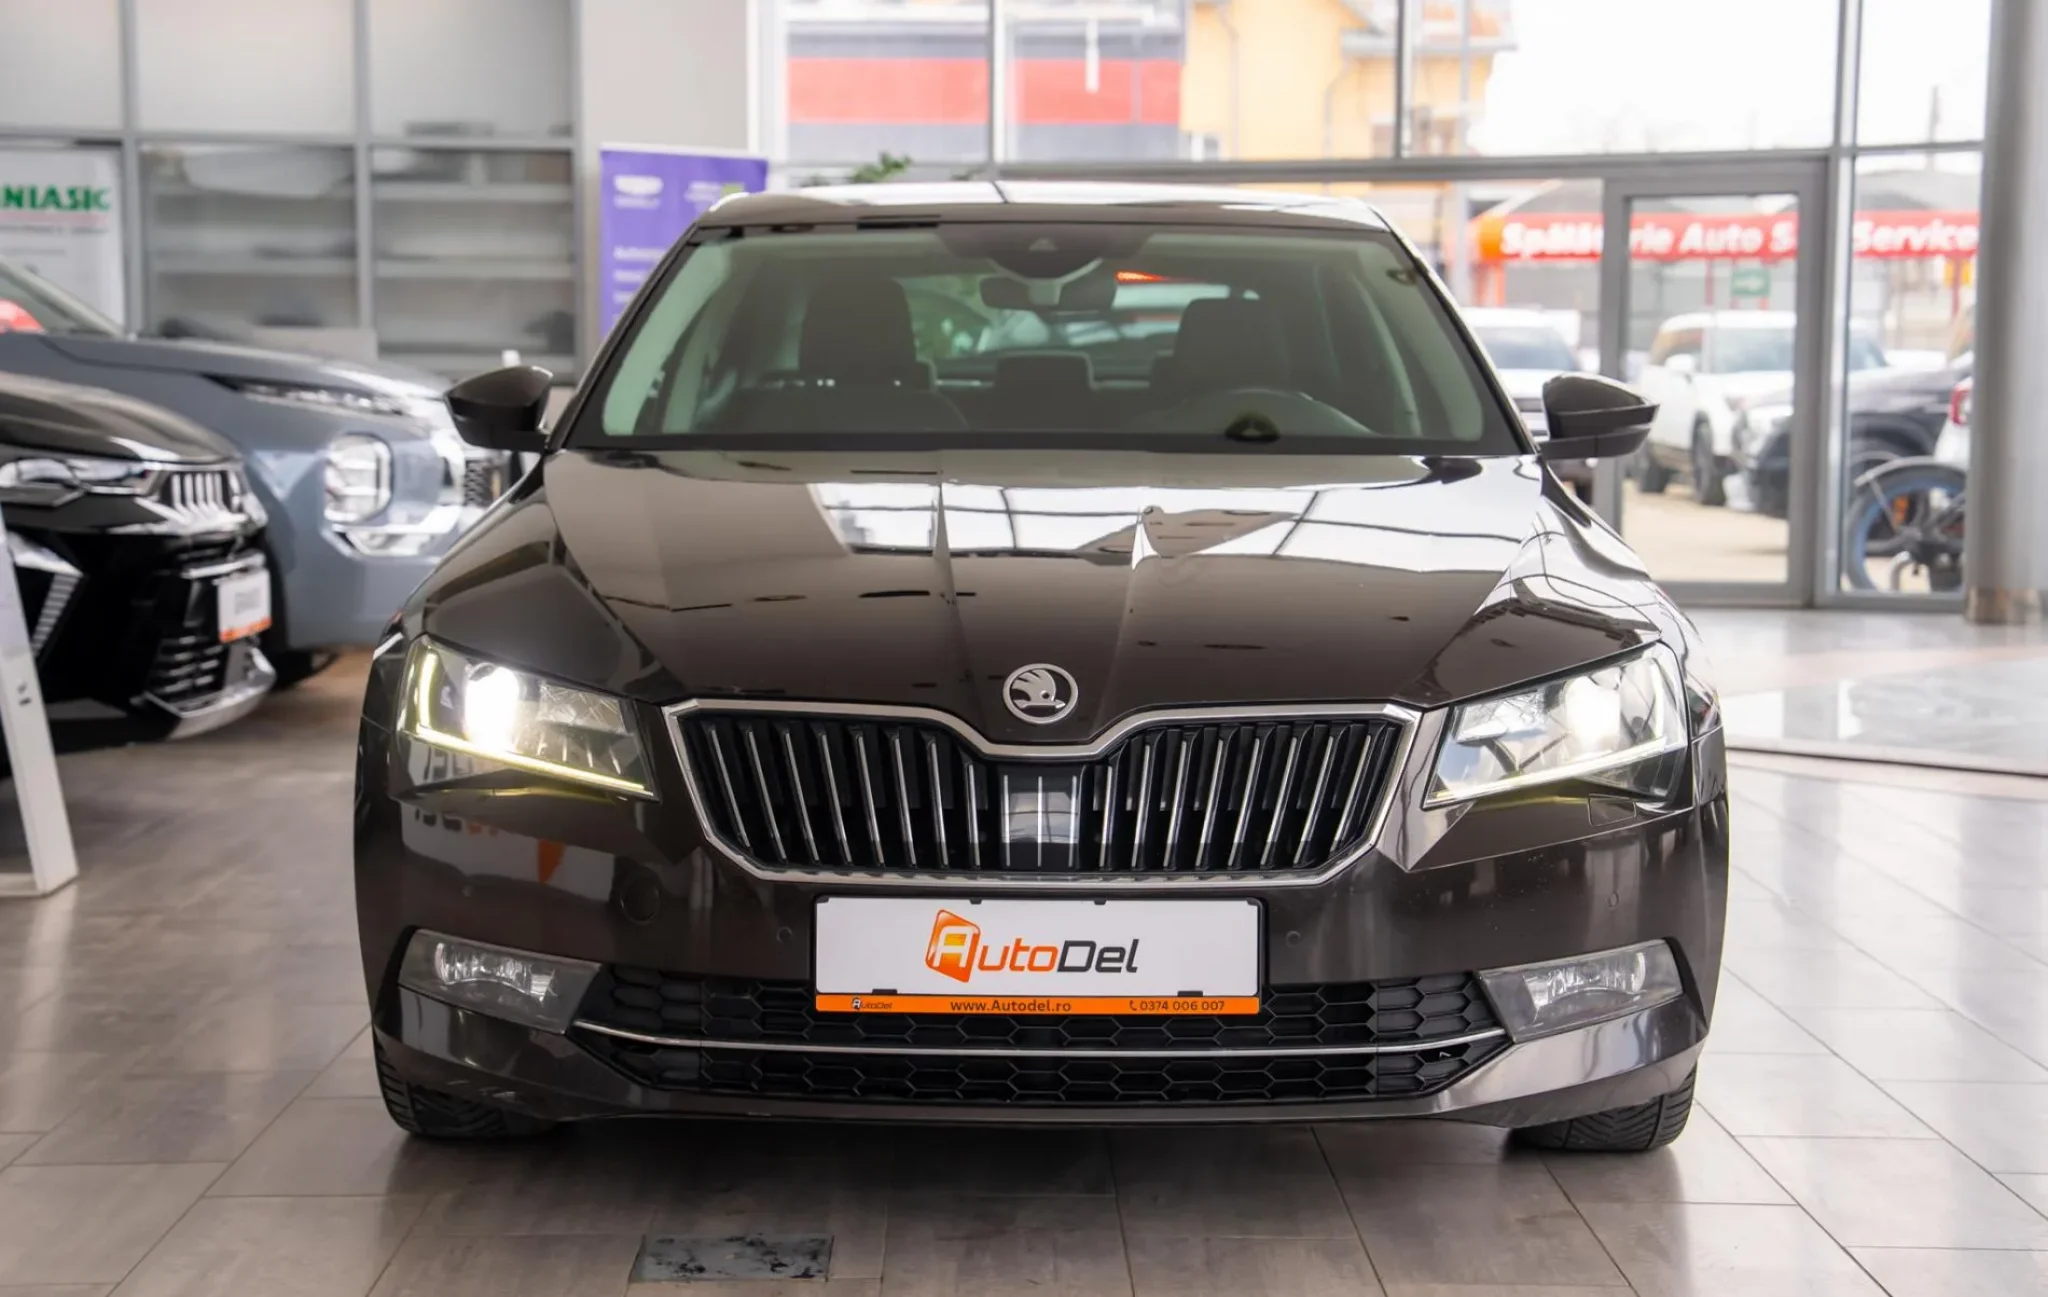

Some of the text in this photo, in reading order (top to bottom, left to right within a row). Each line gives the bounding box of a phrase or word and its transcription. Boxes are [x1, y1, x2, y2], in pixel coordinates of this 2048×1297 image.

[1679, 222, 1763, 254] Auto
[1853, 219, 1979, 252] Service
[929, 920, 1139, 974] AutoDel
[950, 999, 1072, 1013] www.Autodel.ro
[1139, 1000, 1225, 1012] 0374 006 007
